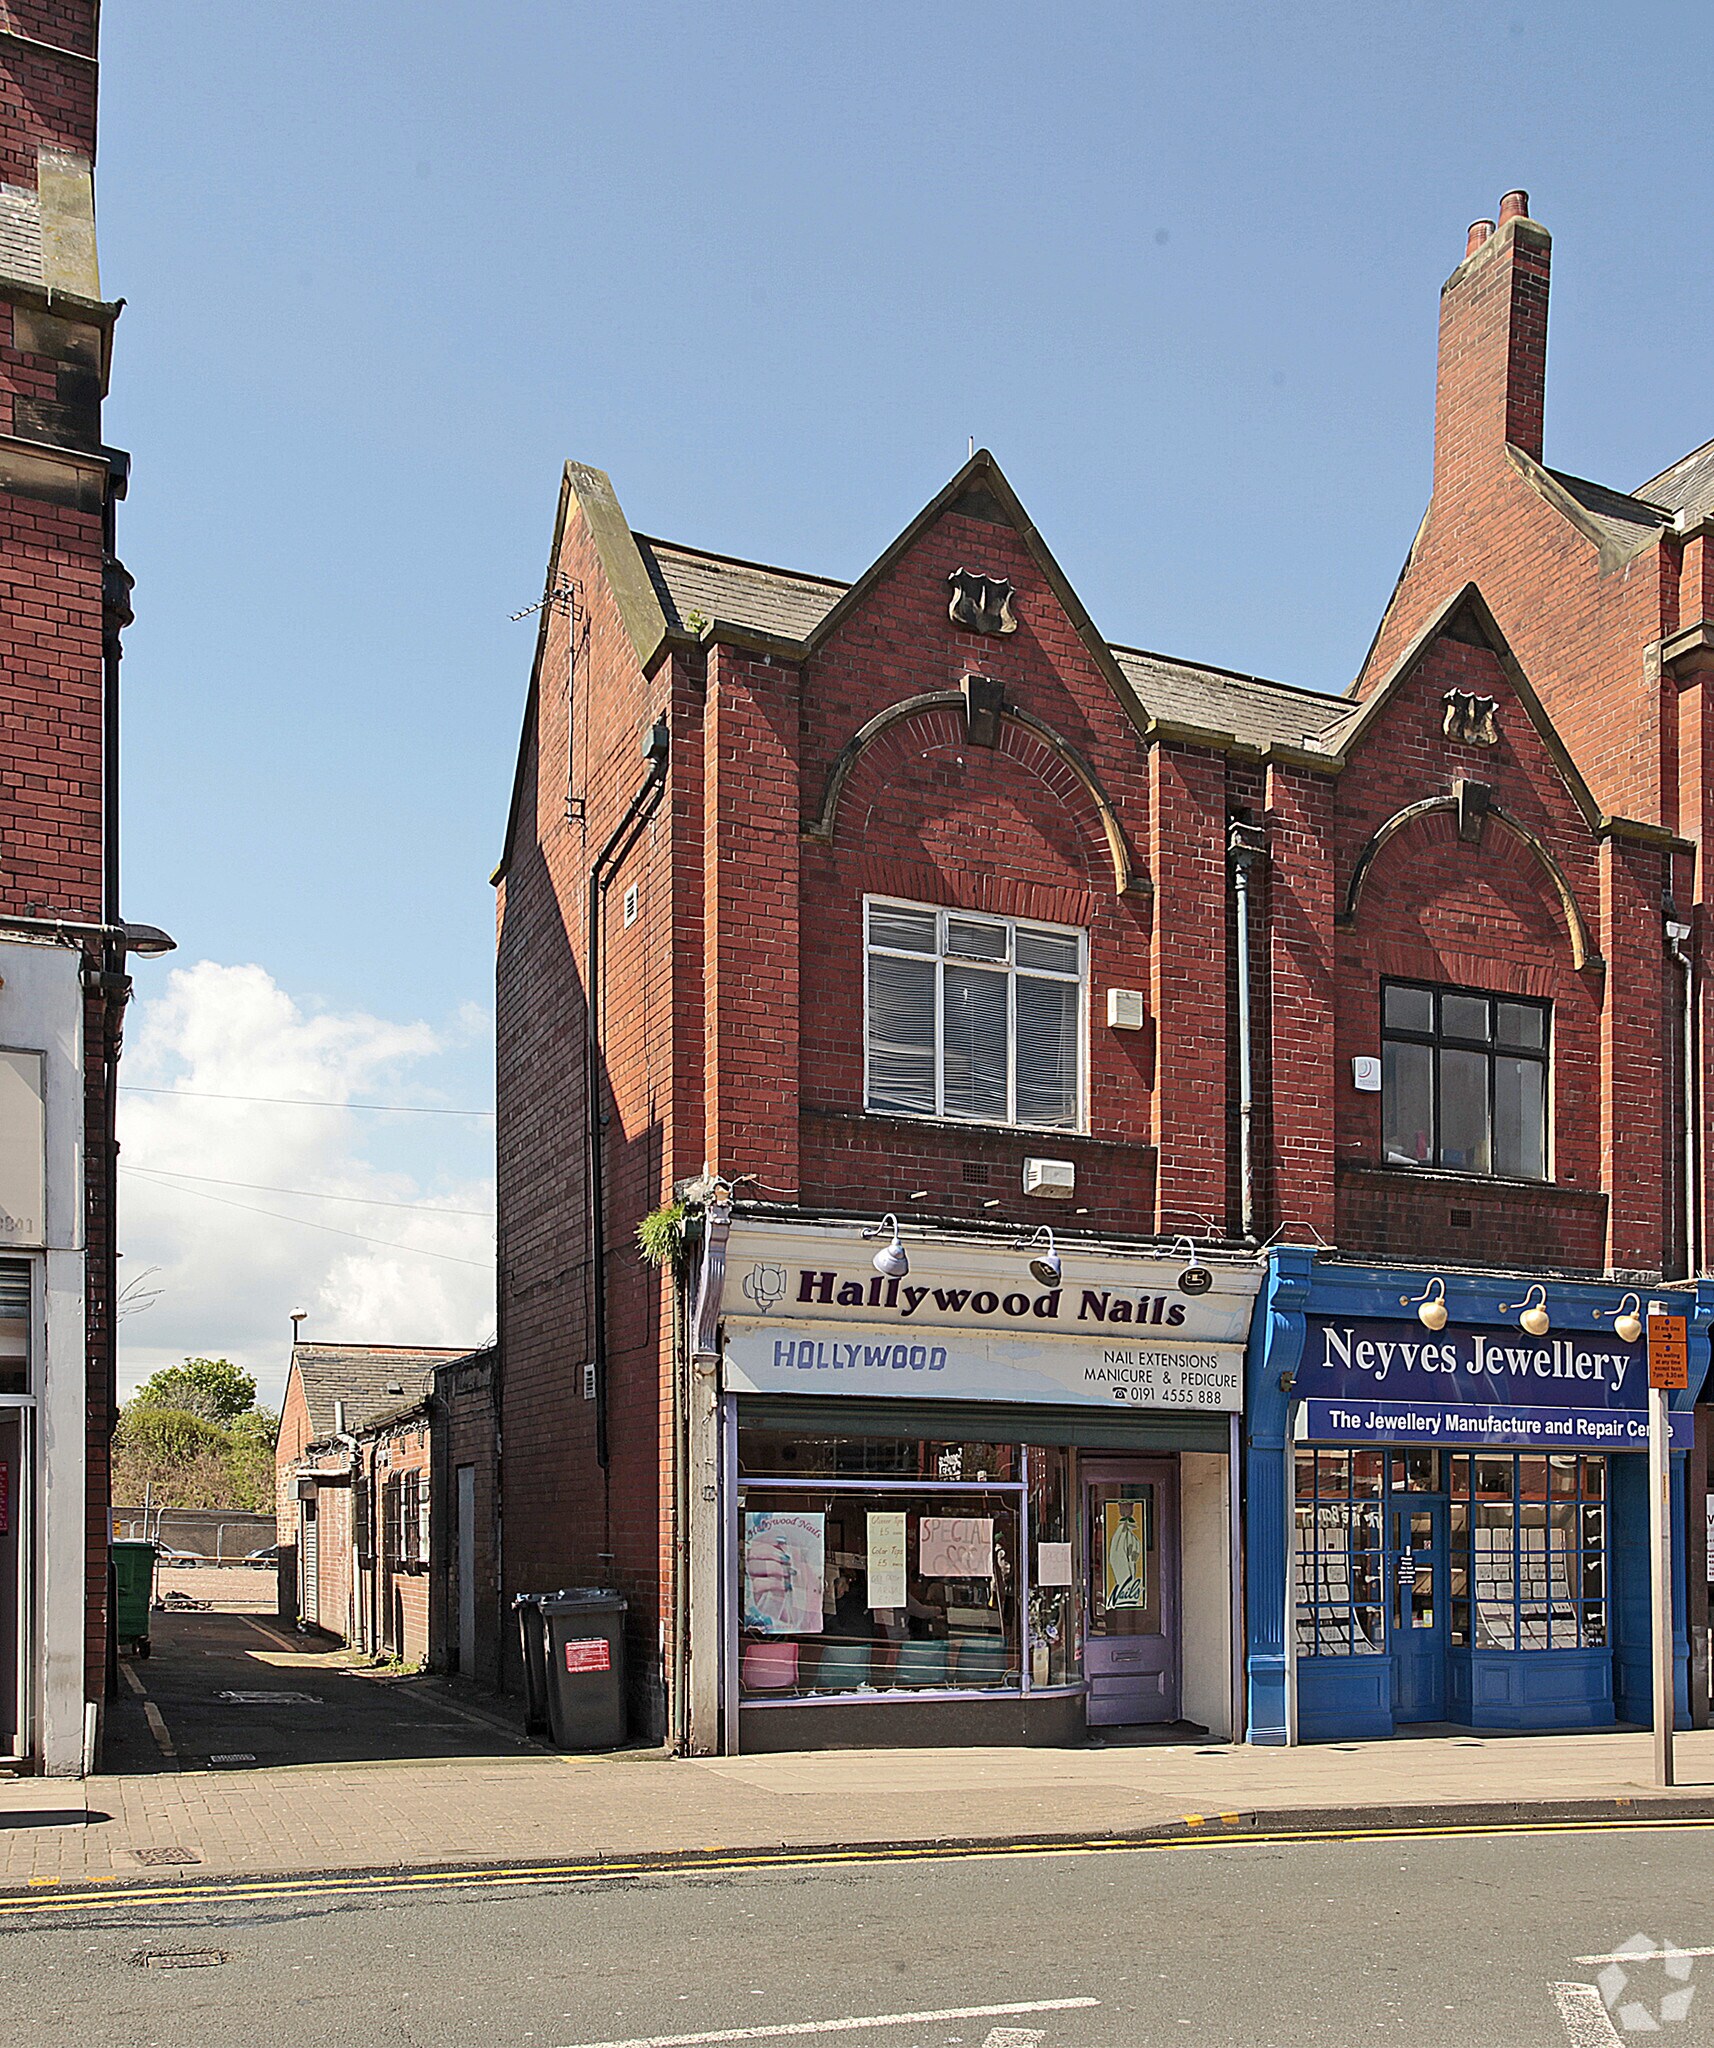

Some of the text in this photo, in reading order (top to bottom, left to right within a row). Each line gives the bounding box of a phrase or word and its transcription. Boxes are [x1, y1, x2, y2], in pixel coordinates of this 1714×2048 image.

[796, 1270, 1186, 1326] Hallywood Nails
[774, 1339, 948, 1371] HOLLYWOOD
[1104, 1350, 1218, 1369] NAIL EXTENSIONS
[1321, 1327, 1630, 1391] Neyves Jewellery
[1084, 1368, 1238, 1388] MANICURE & PEDICURE
[1130, 1388, 1222, 1405] 0191 4555 888
[1329, 1410, 1361, 1428] The
[1365, 1411, 1441, 1435] Jewellery
[1445, 1414, 1542, 1434] Manufacture
[1545, 1419, 1573, 1435] and
[1577, 1419, 1623, 1439] Repair
[798, 1520, 823, 1538] Nails
[921, 1519, 991, 1545] SPECIAL
[1108, 1574, 1141, 1607] Nails
